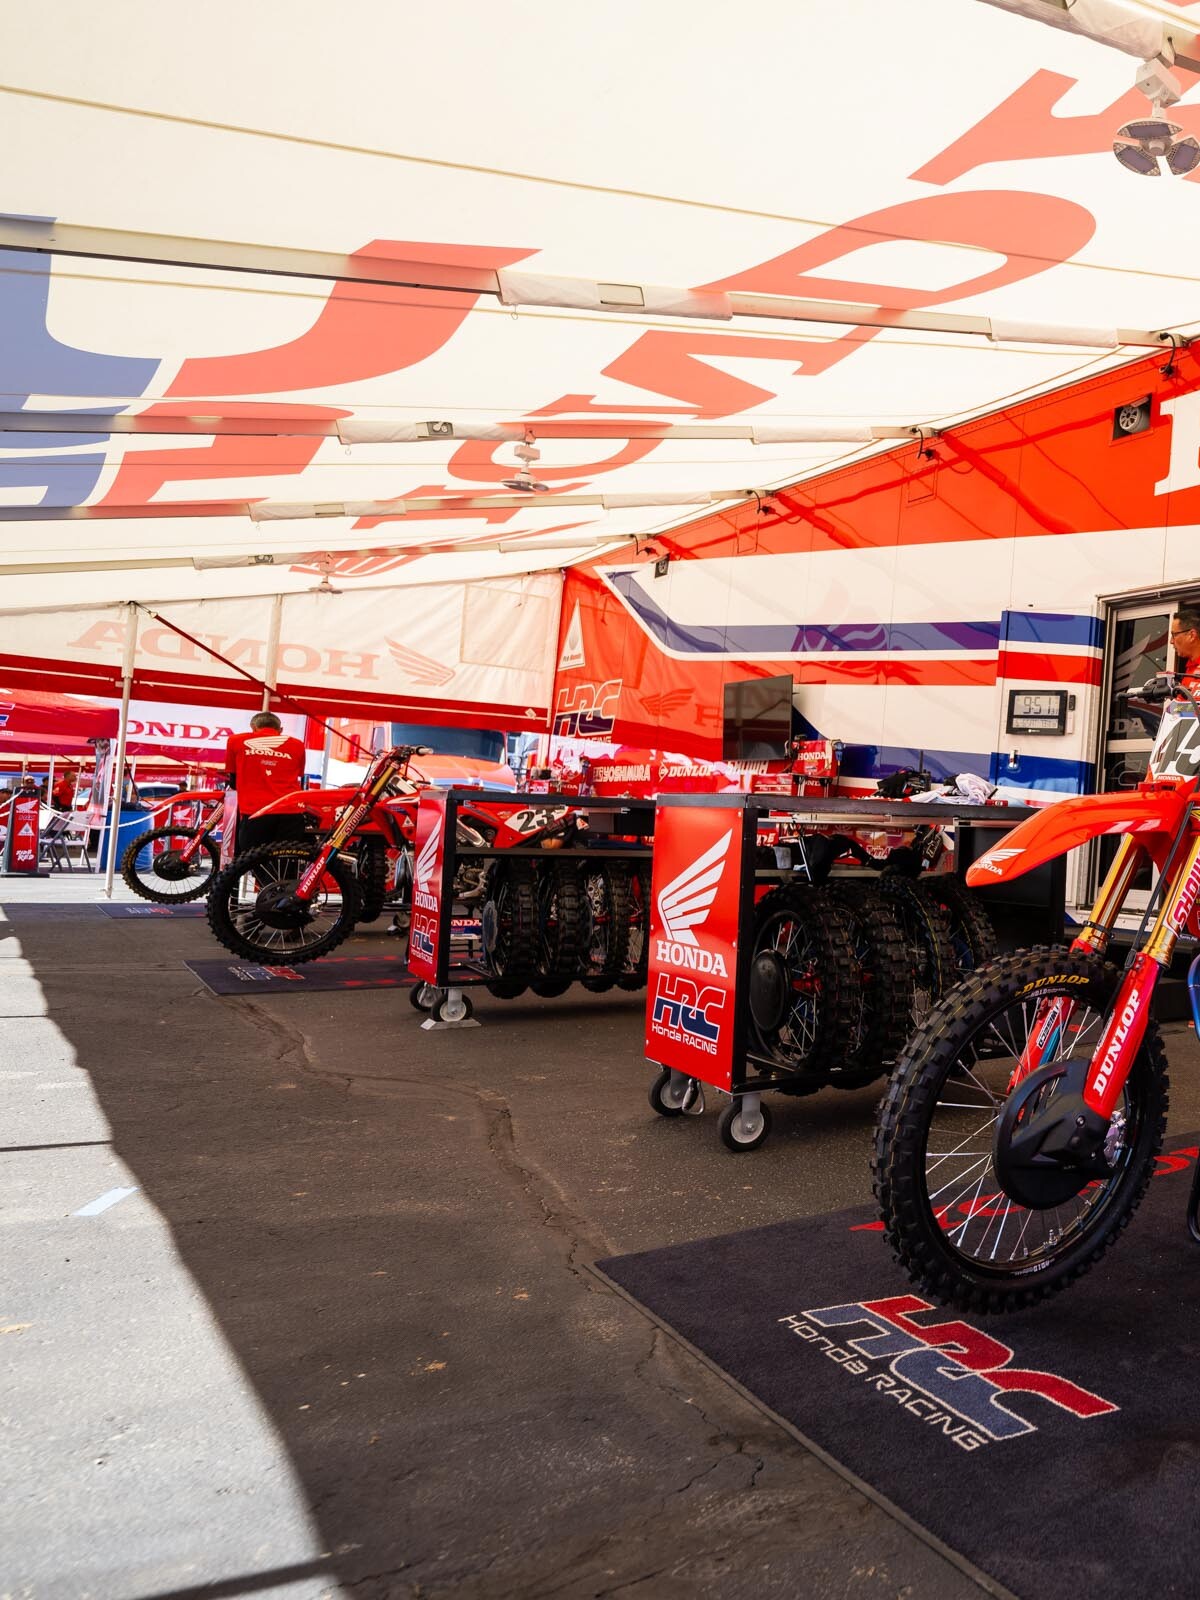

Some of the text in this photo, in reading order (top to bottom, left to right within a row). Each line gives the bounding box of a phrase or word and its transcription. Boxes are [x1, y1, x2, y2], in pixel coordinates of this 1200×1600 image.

[245, 749, 292, 760] HONDA
[668, 763, 715, 777] DUNLOP
[301, 856, 325, 893] DUNLOP
[414, 890, 439, 913] HONDA
[656, 940, 729, 978] HONDA
[1021, 974, 1090, 994] DUNLOP
[652, 972, 727, 1043] HRC
[651, 1022, 718, 1056] Honda RACING
[1092, 988, 1142, 1097] DUNLOP
[777, 1315, 991, 1452] Honda RACING
[801, 1294, 1121, 1442] HRC
